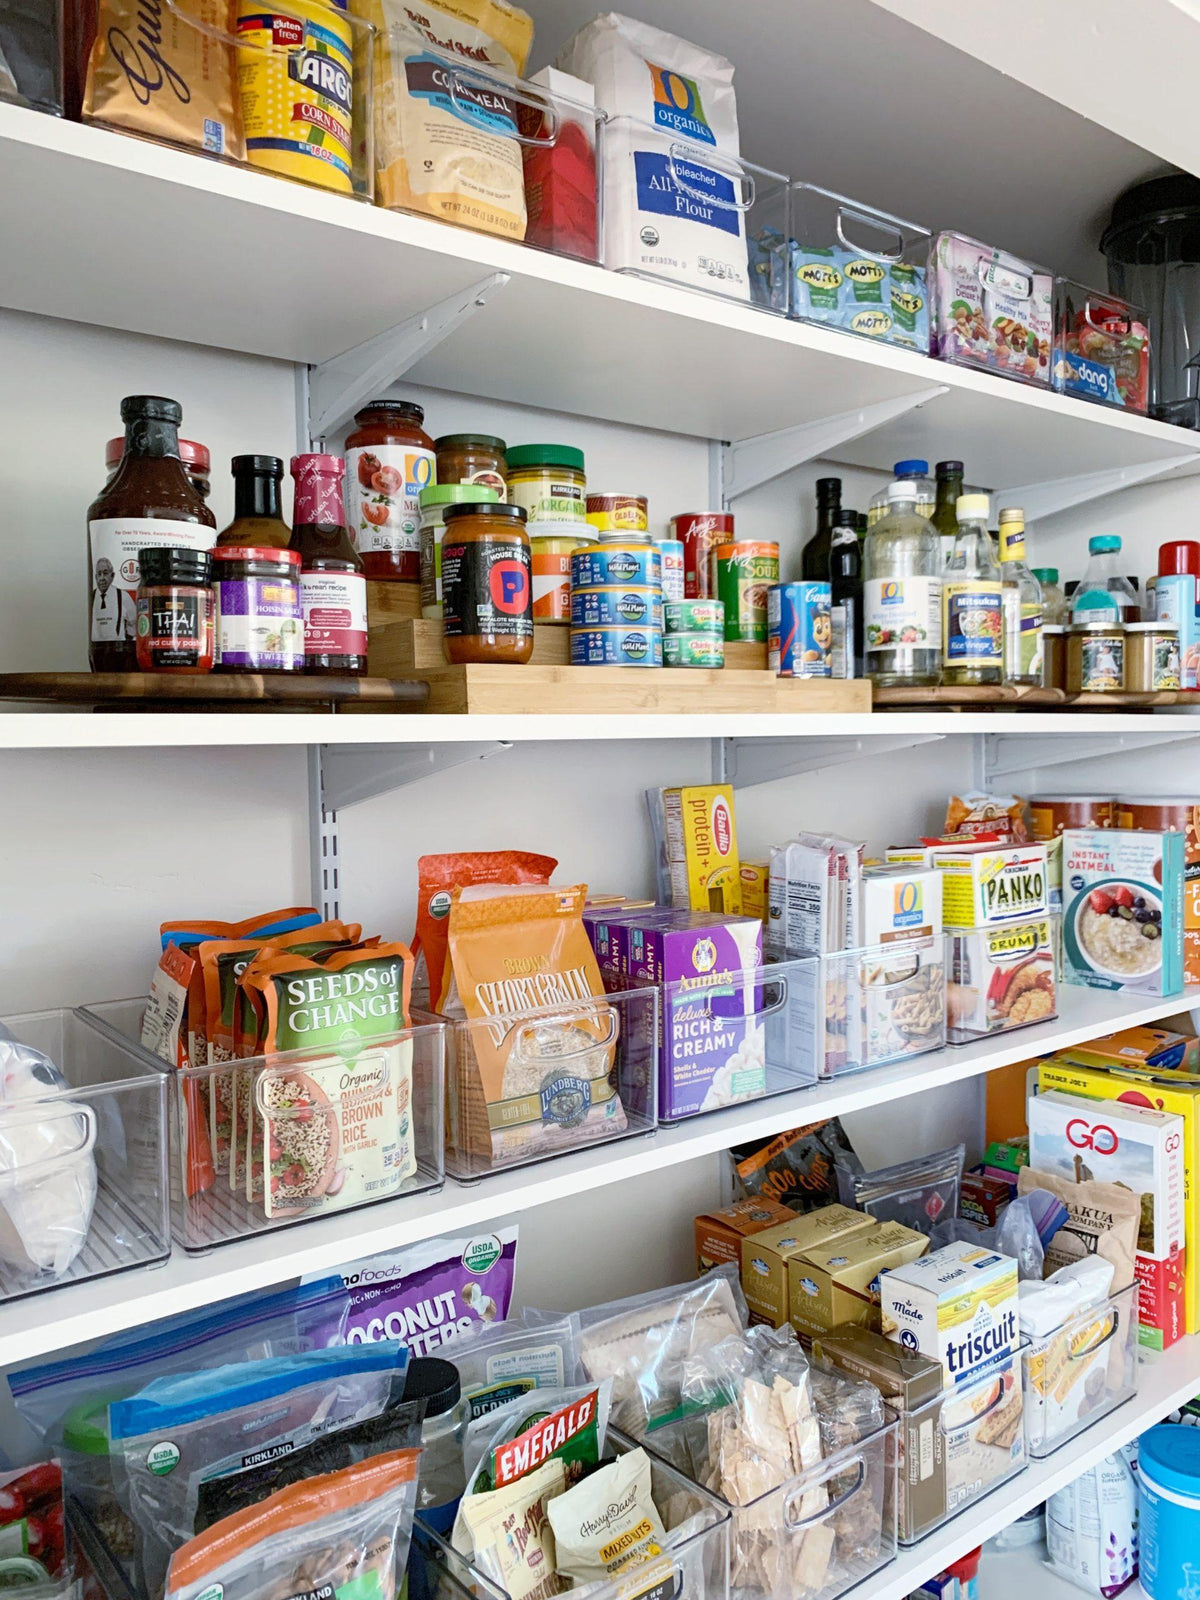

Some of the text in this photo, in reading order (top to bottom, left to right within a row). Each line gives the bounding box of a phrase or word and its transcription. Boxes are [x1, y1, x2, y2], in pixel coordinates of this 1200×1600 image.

[279, 30, 298, 41] free
[424, 29, 492, 62] Red Mill
[301, 104, 331, 128] CORN
[658, 109, 713, 139] organics
[321, 149, 333, 162] OZ
[665, 163, 717, 187] bleached
[441, 201, 452, 211] NET
[453, 202, 461, 212] WT
[462, 204, 471, 215] 24
[675, 195, 714, 220] Flour
[995, 302, 1016, 318] Healthy
[1079, 363, 1108, 393] dang
[552, 485, 581, 495] KIRKLAND
[685, 517, 719, 543] Amy's
[490, 551, 513, 561] HOUSE
[608, 562, 640, 571] Wild Planet
[726, 546, 760, 573] Amy's
[616, 603, 647, 613] Wild Planet
[957, 597, 1000, 607] Mitsukan
[153, 611, 195, 629] THAI
[148, 639, 160, 647] red
[621, 643, 650, 652] Wild Planet
[951, 641, 963, 650] Rice
[688, 799, 712, 857] protein
[716, 809, 730, 852] Barilla
[1072, 851, 1111, 860] INSTANT
[1066, 860, 1117, 873] OATMEAL
[788, 880, 821, 891] Nutrition Facts
[987, 873, 1043, 906] PANKO
[809, 903, 821, 911] 350
[503, 955, 550, 976] BROWN
[287, 963, 398, 1006] SEEDS of
[678, 967, 734, 994] Annie's
[288, 989, 400, 1034] CHANGE
[673, 1018, 723, 1041] RICH &
[672, 1031, 737, 1059] CREAMY
[673, 1063, 692, 1073] Shells
[673, 1066, 716, 1081] White Cheddar
[339, 1068, 383, 1090] Organic
[1043, 1073, 1087, 1088] TRADER JOE'S
[541, 1077, 590, 1113] LUNDBERG
[341, 1101, 384, 1127] BROWN
[342, 1123, 367, 1145] RICE
[356, 1138, 378, 1150] GARLIC
[1066, 1118, 1119, 1156] GO
[1164, 1133, 1180, 1154] GO
[761, 1152, 831, 1204] BOO CHIPS
[467, 1252, 496, 1265] ORGANIC
[472, 1241, 494, 1255] USDA
[937, 1268, 967, 1284] triscuit
[346, 1289, 457, 1346] OCONUT
[892, 1301, 924, 1321] Made
[946, 1309, 1016, 1374] triscuit
[501, 1400, 592, 1482] EMERALD
[153, 1449, 174, 1460] USDA
[245, 1444, 294, 1466] KIRKLAND
[513, 1519, 530, 1559] Red
[527, 1496, 545, 1538] Mill
[602, 1530, 634, 1560] MIXED
